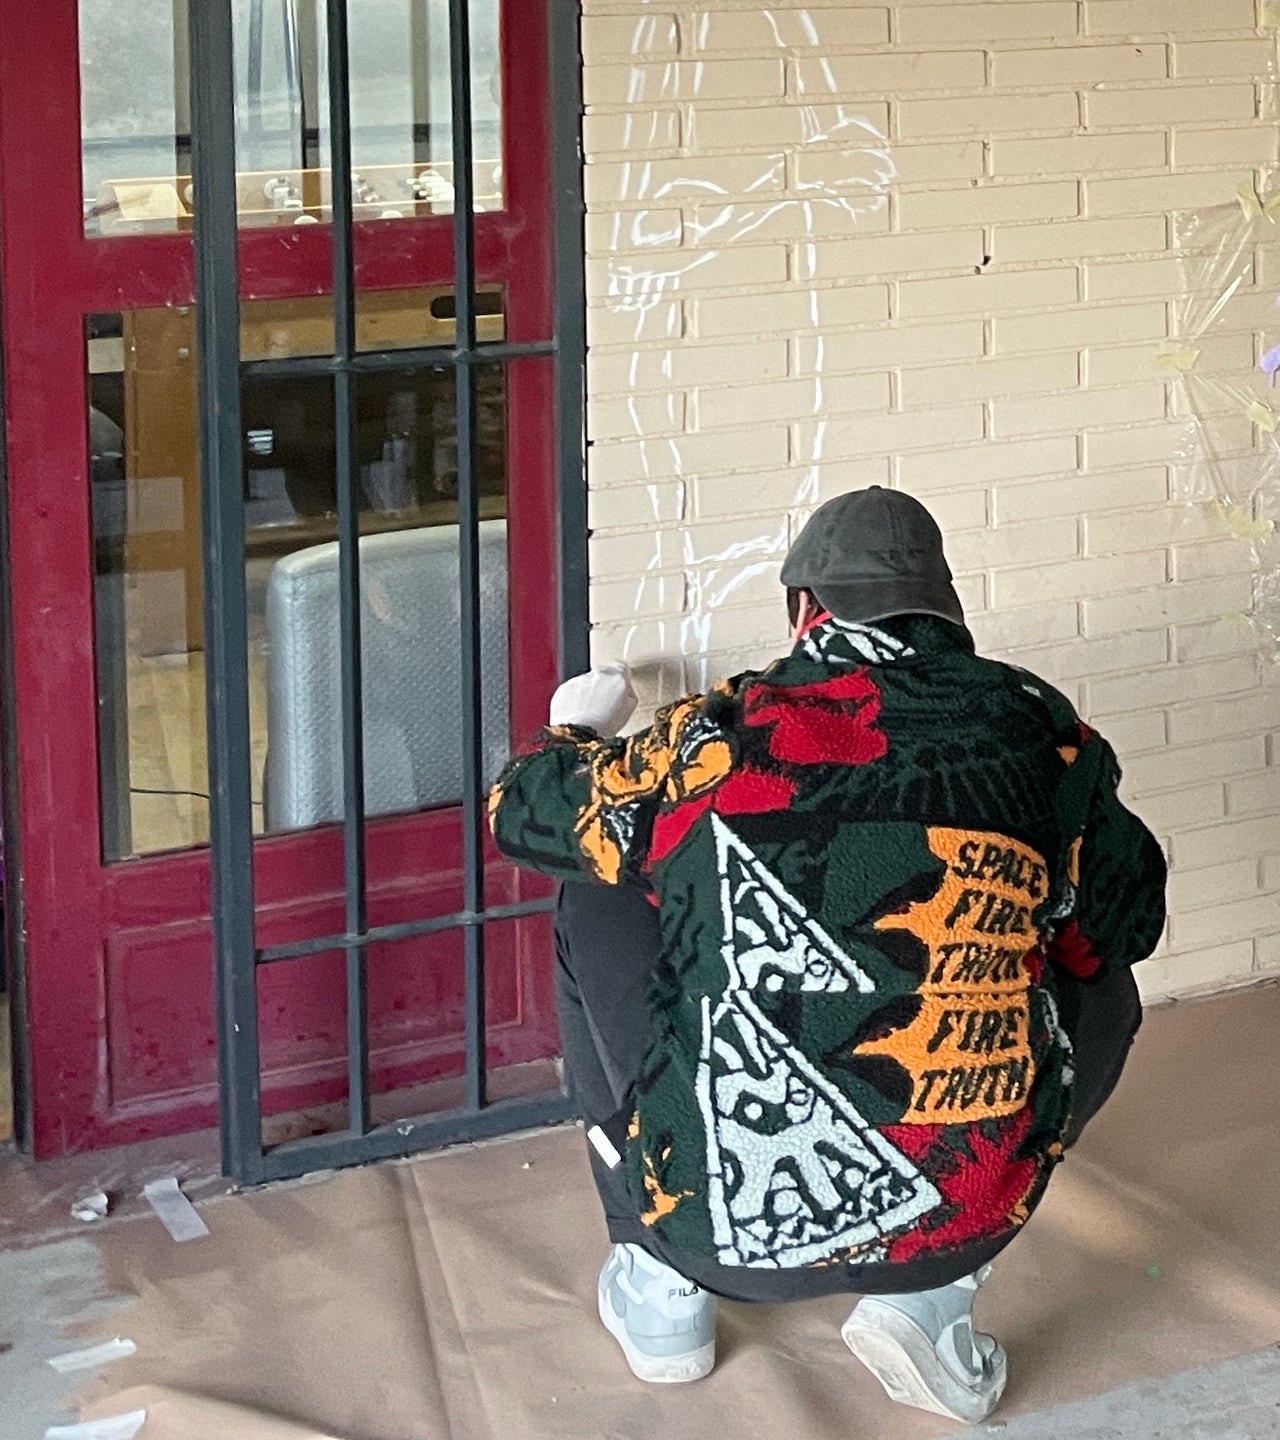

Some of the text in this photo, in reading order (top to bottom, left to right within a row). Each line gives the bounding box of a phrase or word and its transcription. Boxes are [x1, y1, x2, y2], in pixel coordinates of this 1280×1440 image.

[952, 841, 1046, 898] SPACE
[945, 889, 1029, 935] FIRE
[927, 1009, 1024, 1054] FIRE
[914, 1056, 1029, 1111] TRUTH
